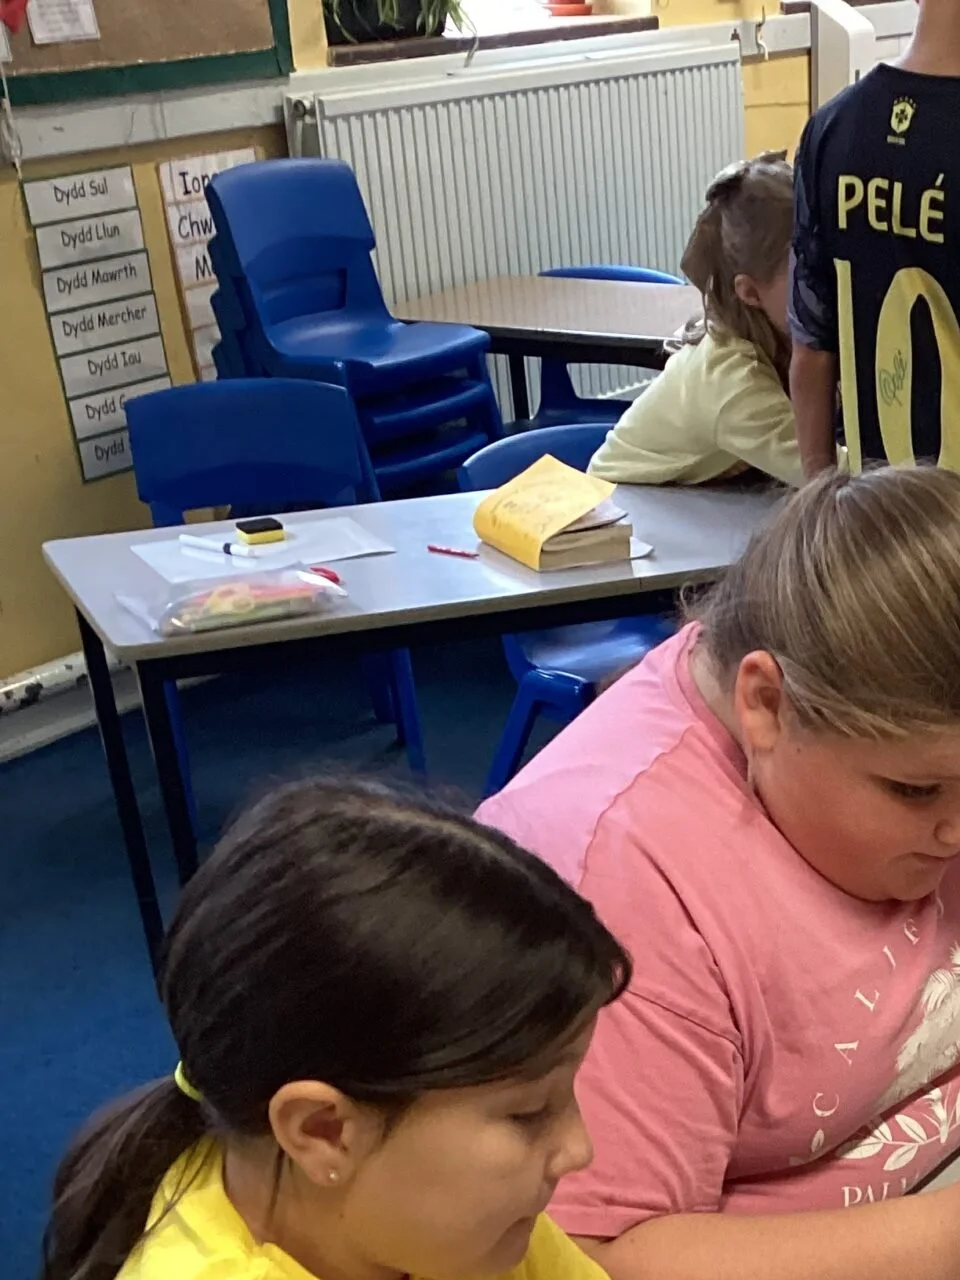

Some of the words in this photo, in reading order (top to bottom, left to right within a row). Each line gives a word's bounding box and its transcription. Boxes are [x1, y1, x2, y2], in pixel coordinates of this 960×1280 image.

[54, 181, 86, 206] Dydd
[89, 176, 108, 197] Sul
[837, 173, 944, 244] PELÉ
[61, 224, 92, 249] Dydd
[95, 221, 120, 241] Llun
[56, 271, 88, 298] Dydd
[91, 262, 137, 286] Mawrth
[62, 313, 94, 339] Dydd
[97, 305, 147, 329] Mercher
[87, 352, 119, 377] Dydd
[120, 350, 142, 367] Iau
[85, 396, 116, 421] Dydd
[95, 437, 125, 462] Dydd
